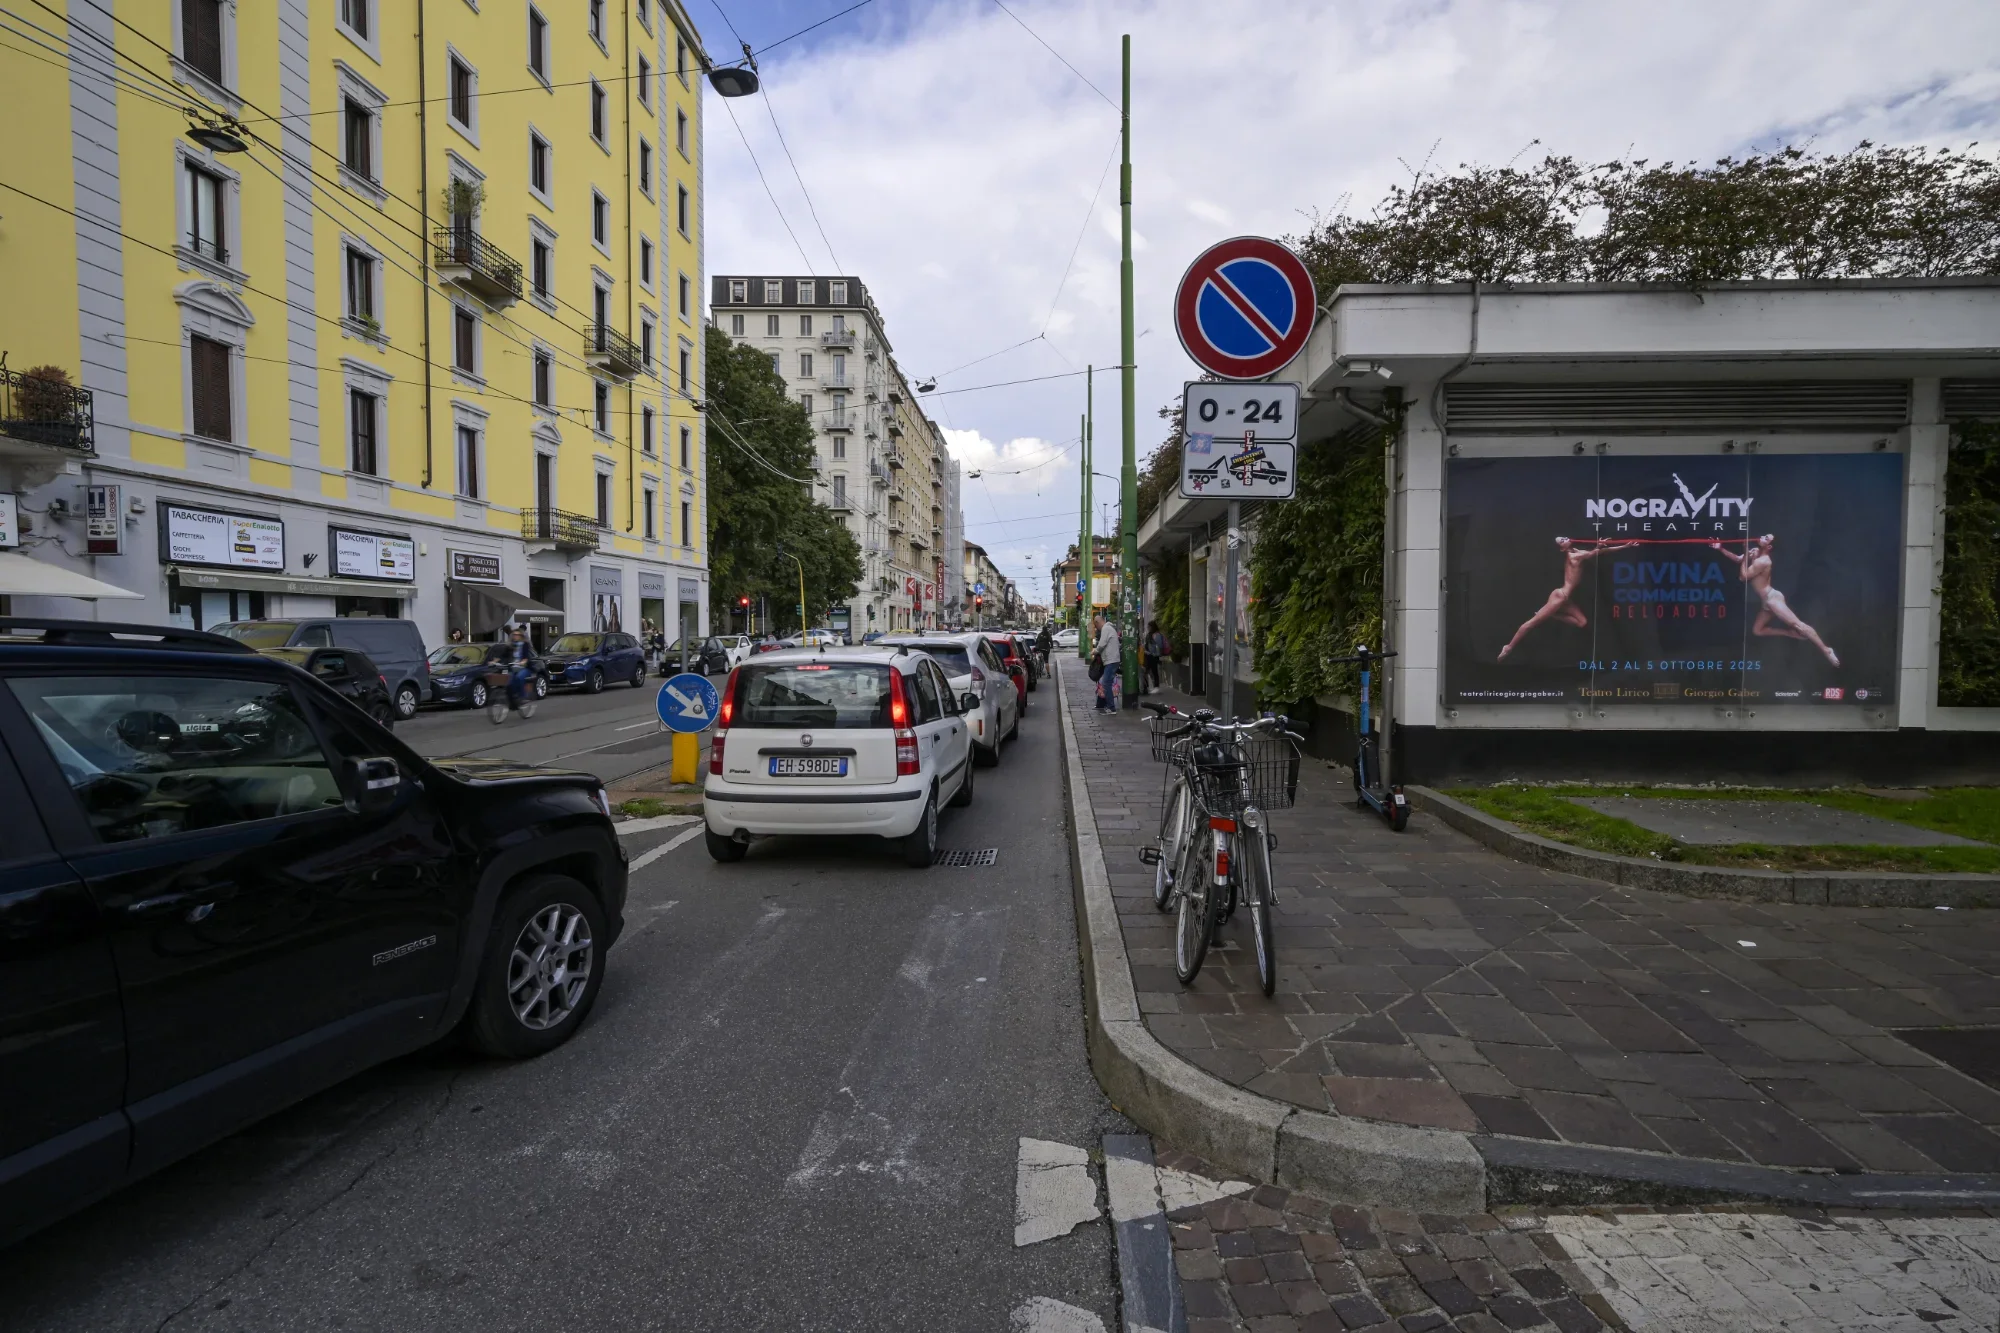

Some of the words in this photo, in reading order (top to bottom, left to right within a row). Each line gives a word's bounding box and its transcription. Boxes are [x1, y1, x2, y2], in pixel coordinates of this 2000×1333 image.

[1200, 399, 1218, 422] 0
[1243, 399, 1282, 423] 24
[1586, 473, 1754, 519] NOGRAVITY
[171, 510, 224, 525] TABACCHERIA
[233, 519, 281, 532] SuperEnalotto
[1593, 522, 1748, 531] THEATRE
[172, 531, 206, 540] CAFFETTERIA
[338, 532, 374, 544] TABACCHERIA
[1613, 562, 1725, 584] DIVINA
[596, 578, 619, 587] GANT
[643, 582, 662, 591] GANT
[681, 587, 697, 595] GANT
[1614, 589, 1725, 602] COMMEDIA
[1613, 605, 1727, 618] RELOADED
[1579, 660, 1605, 670] DAL
[1611, 660, 1618, 670] 2
[1624, 660, 1640, 670] AL
[1647, 660, 1653, 670] 5
[1660, 660, 1723, 670] OTTOBRE
[1730, 660, 1761, 670] 2025
[1459, 690, 1564, 698] teatroliricogiorgiogaber.it
[1578, 687, 1613, 697] Teatro
[1616, 687, 1650, 697] Lirico
[1684, 687, 1725, 699] Giorgio
[1728, 687, 1761, 698] Gaber
[1825, 687, 1840, 697] RDS
[778, 759, 793, 773] EH
[798, 759, 839, 773] 598DE
[373, 934, 437, 966] RENEGADE
